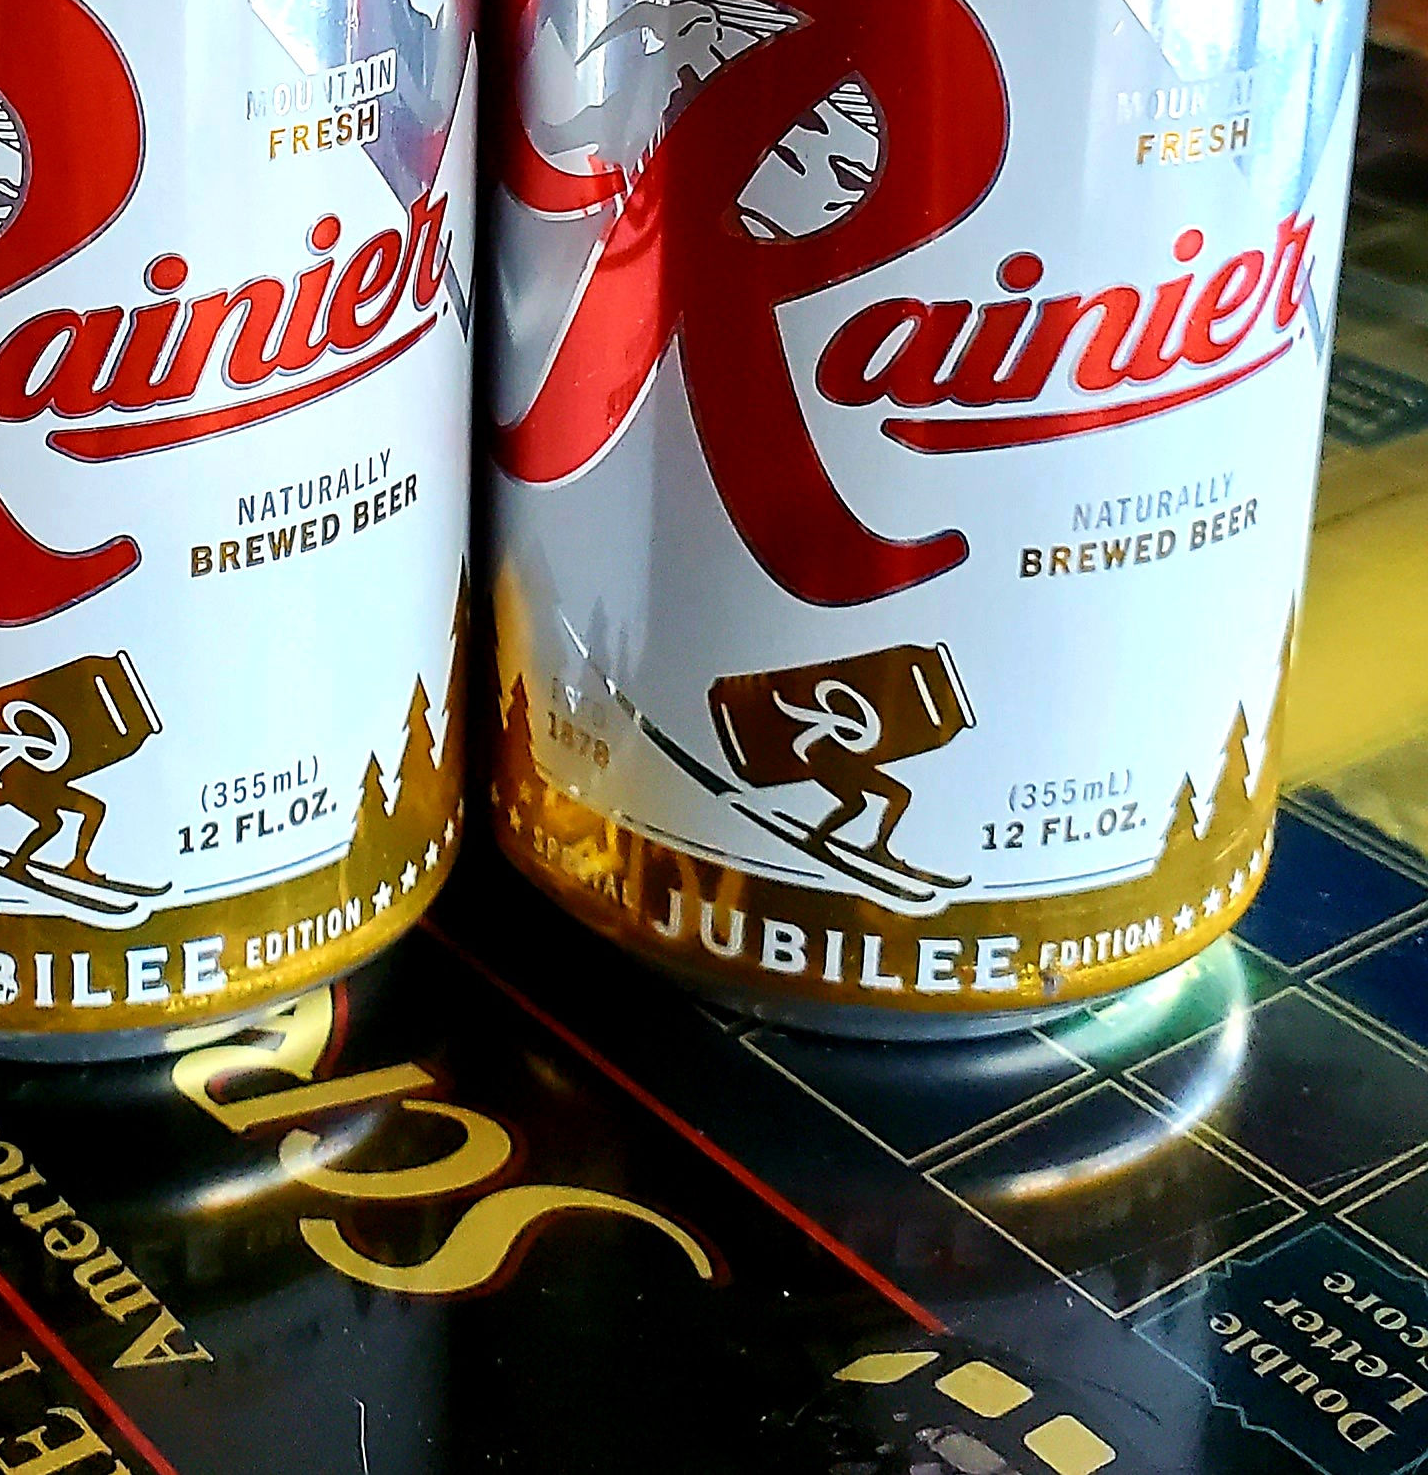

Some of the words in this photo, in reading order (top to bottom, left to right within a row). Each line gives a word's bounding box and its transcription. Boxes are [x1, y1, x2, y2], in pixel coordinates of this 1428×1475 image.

[268, 105, 377, 161] FRESH
[1135, 117, 1251, 167] FRESH
[236, 447, 392, 527] NATURALLY
[1071, 470, 1235, 533] NATURALLY
[188, 511, 341, 579] BREWED
[352, 472, 420, 536] BEER
[1018, 528, 1177, 579] BREWED
[1188, 497, 1260, 552] BEER
[199, 755, 321, 813] (355mL)
[1006, 766, 1134, 813] (355mL)
[177, 822, 220, 855] 12
[234, 785, 338, 844] FL.OZ.
[980, 820, 1025, 851] 12
[1041, 798, 1149, 846] FL.OZ.
[244, 904, 362, 969] EDITION
[652, 888, 1021, 996] JUBILEE
[1039, 915, 1164, 974] EDITION
[1208, 1309, 1398, 1453] Double
[1263, 1296, 1428, 1414] Letter
